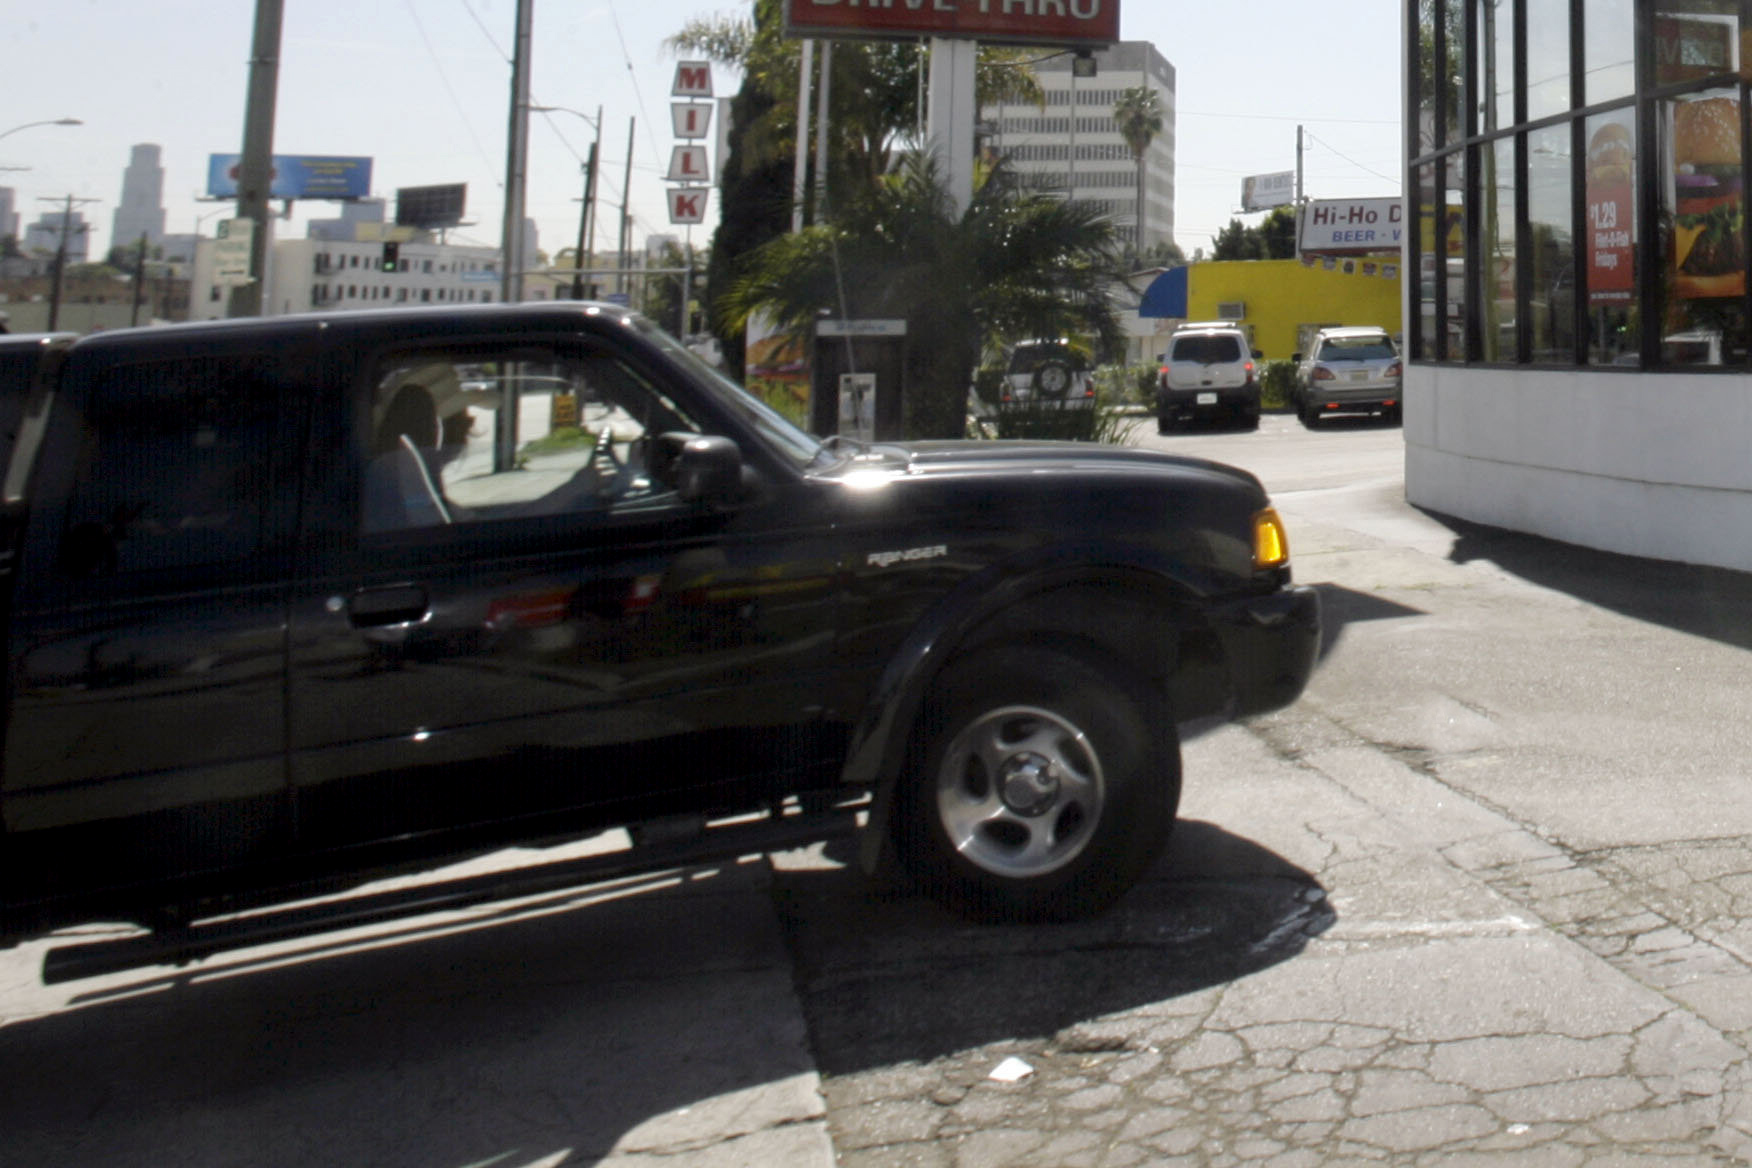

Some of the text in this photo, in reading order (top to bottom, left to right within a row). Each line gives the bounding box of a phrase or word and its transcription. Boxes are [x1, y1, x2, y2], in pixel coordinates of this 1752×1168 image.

[674, 66, 708, 217] MILK
[1312, 205, 1379, 226] Hi-Ho
[1331, 230, 1376, 243] BEER
